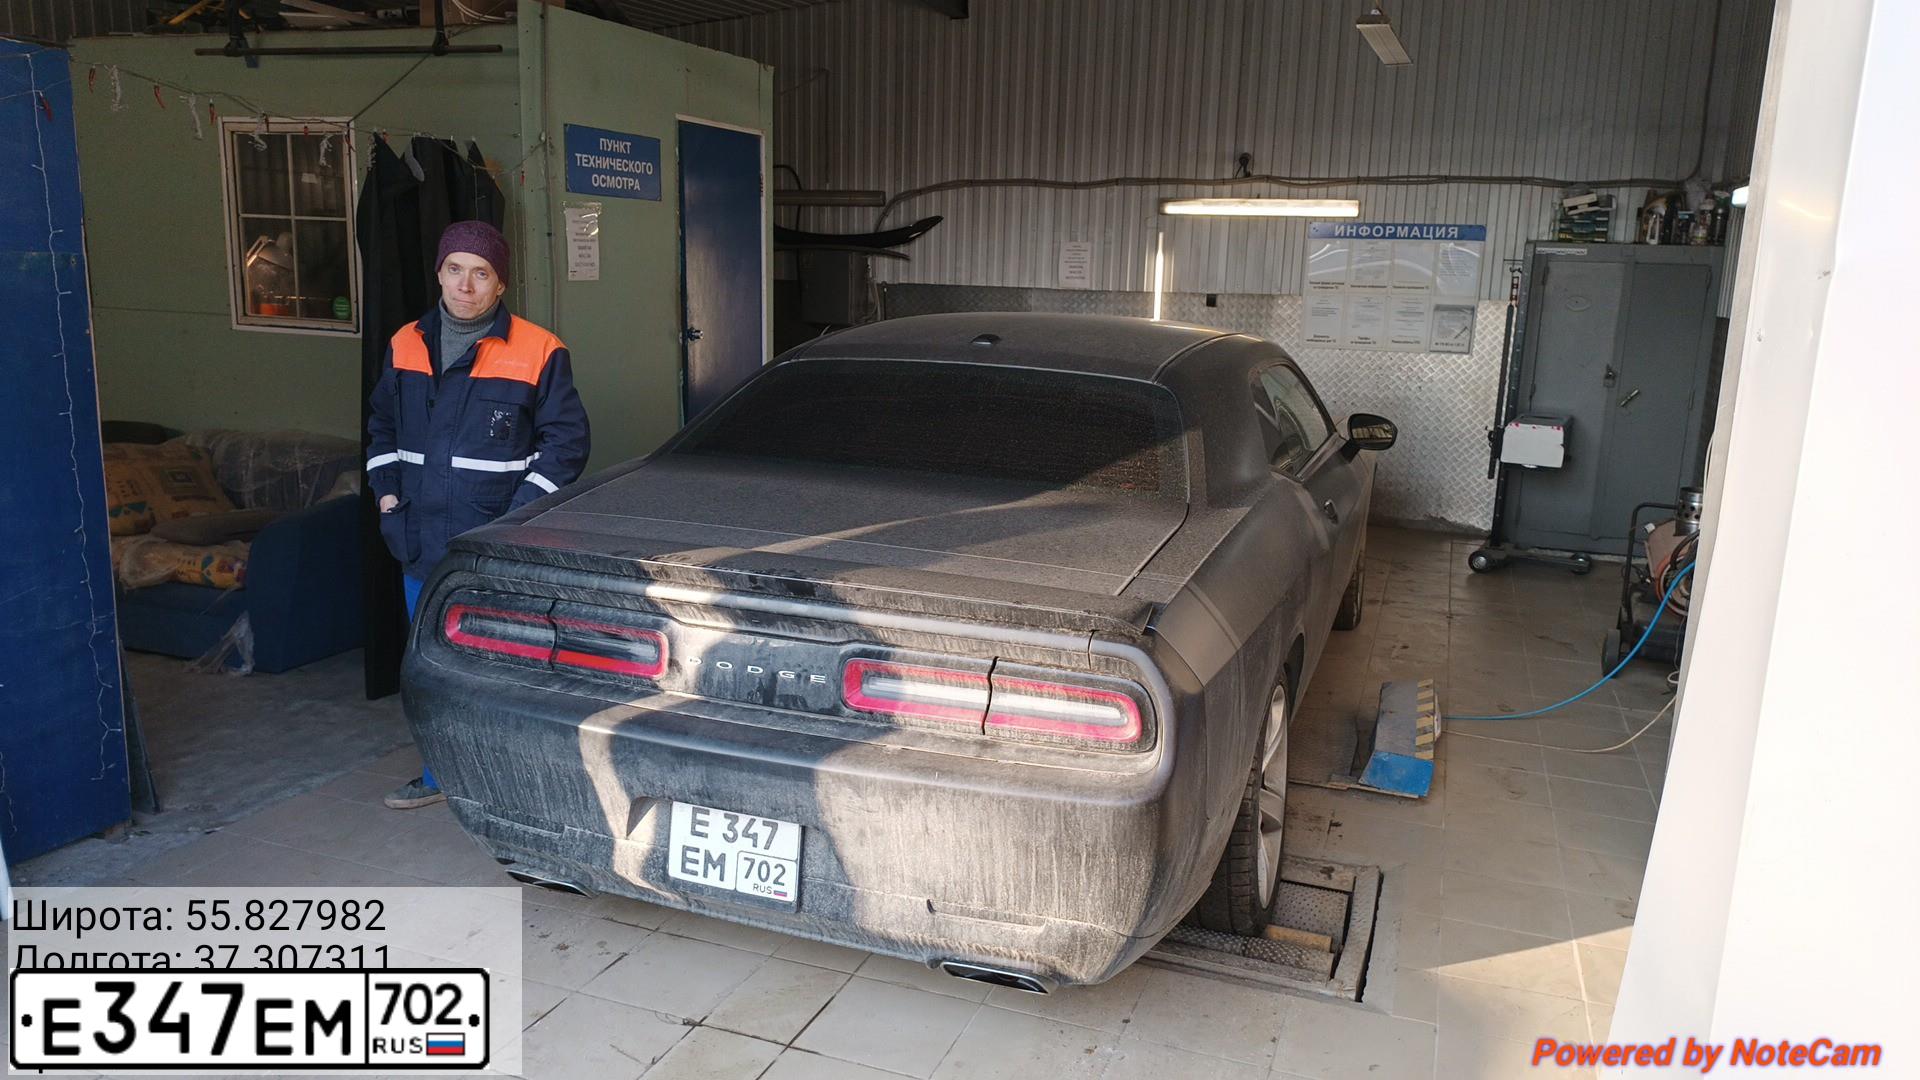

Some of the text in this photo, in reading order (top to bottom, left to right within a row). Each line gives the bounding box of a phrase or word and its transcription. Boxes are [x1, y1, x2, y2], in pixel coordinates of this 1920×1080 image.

[600, 138, 631, 154] ПУНКТ
[575, 153, 653, 175] ТЕХНИЧЕСКОГО
[592, 174, 640, 191] ОСМОТРА
[1334, 225, 1459, 240] ИНФОРМАЦИЯ
[687, 656, 826, 684] DODGE
[722, 813, 779, 850] 347
[680, 845, 726, 882] ЕМ
[743, 857, 786, 887] 702
[752, 883, 772, 894] RUS
